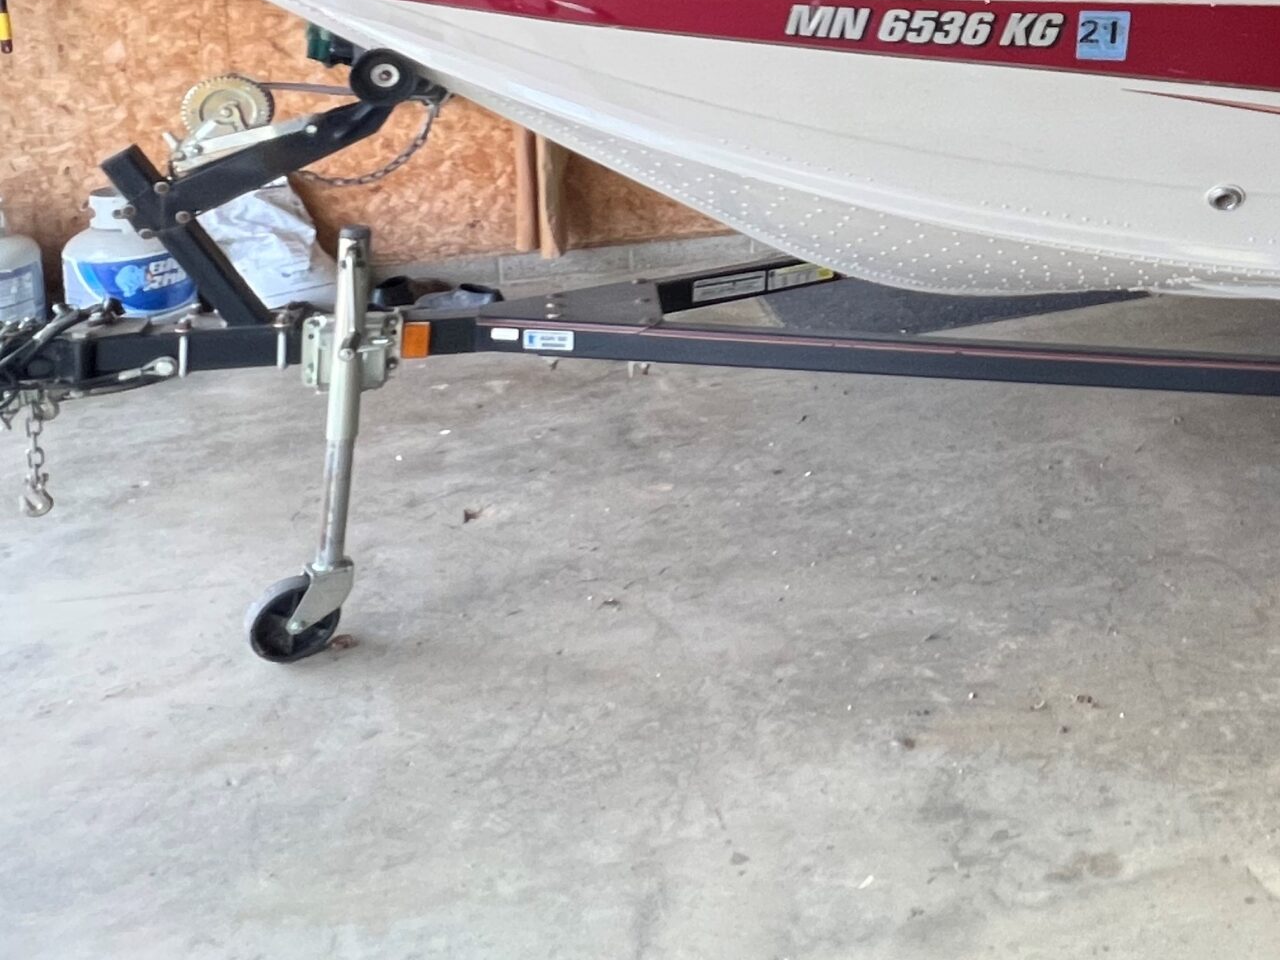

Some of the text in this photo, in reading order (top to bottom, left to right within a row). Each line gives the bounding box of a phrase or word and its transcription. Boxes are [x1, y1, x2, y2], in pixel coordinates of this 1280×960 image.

[785, 4, 1065, 47] MN 6536 KG
[1079, 19, 1118, 44] 21
